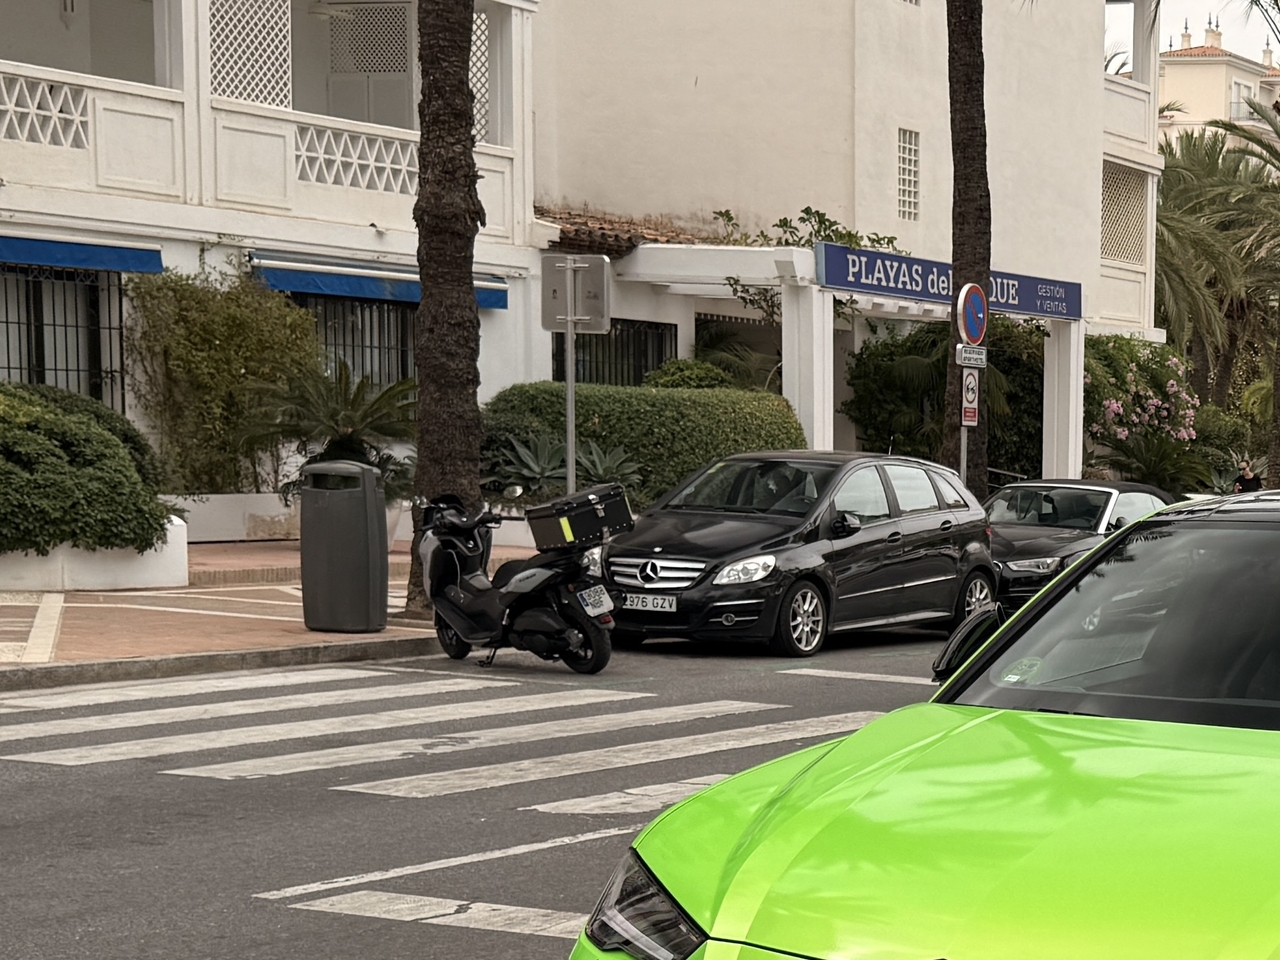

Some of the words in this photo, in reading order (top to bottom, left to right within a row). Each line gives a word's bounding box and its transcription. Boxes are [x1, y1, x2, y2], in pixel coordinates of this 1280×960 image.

[847, 254, 923, 292] PLAYAS
[927, 267, 953, 296] del
[1037, 284, 1065, 299] GESTIÓN
[1036, 300, 1041, 310] Y
[1042, 300, 1067, 313] VENTAS
[652, 597, 674, 609] GZV
